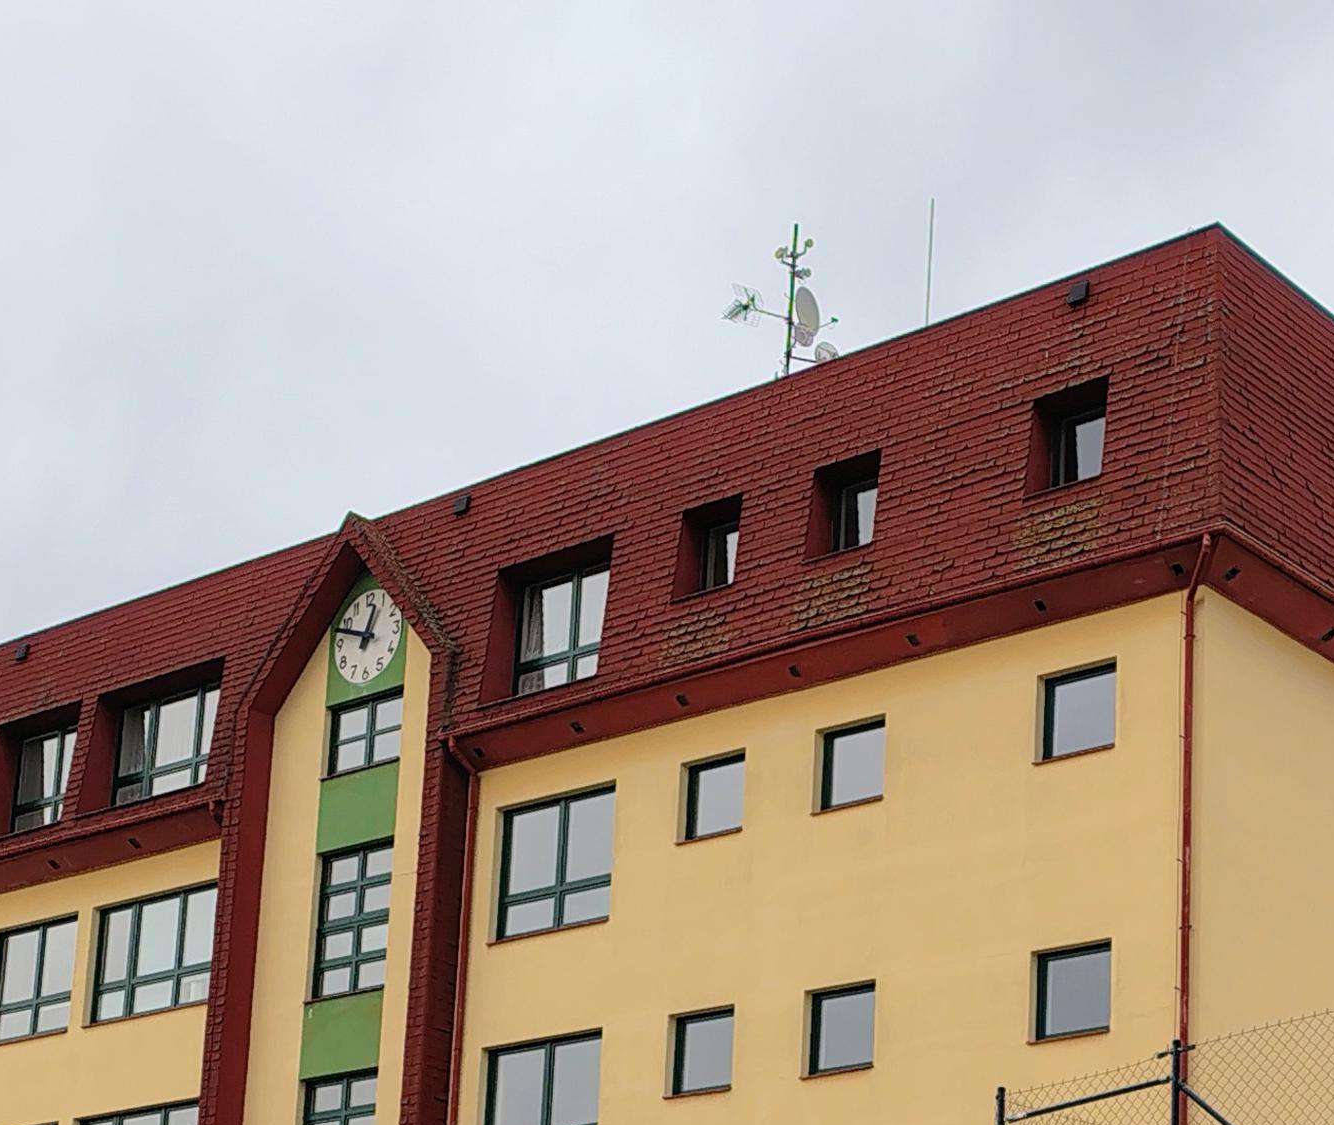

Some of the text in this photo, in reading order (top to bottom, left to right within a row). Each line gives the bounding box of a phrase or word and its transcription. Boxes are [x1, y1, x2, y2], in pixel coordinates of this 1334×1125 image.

[365, 592, 375, 608] 12
[382, 592, 386, 608] 1
[353, 602, 360, 617] 11
[389, 603, 397, 617] 2
[343, 617, 353, 630] 10
[392, 620, 400, 635] 3
[336, 638, 344, 652] 9
[387, 640, 395, 654] 4
[339, 655, 347, 670] 8
[376, 656, 384, 671] 5
[350, 664, 358, 679] 7
[361, 666, 369, 680] 6
